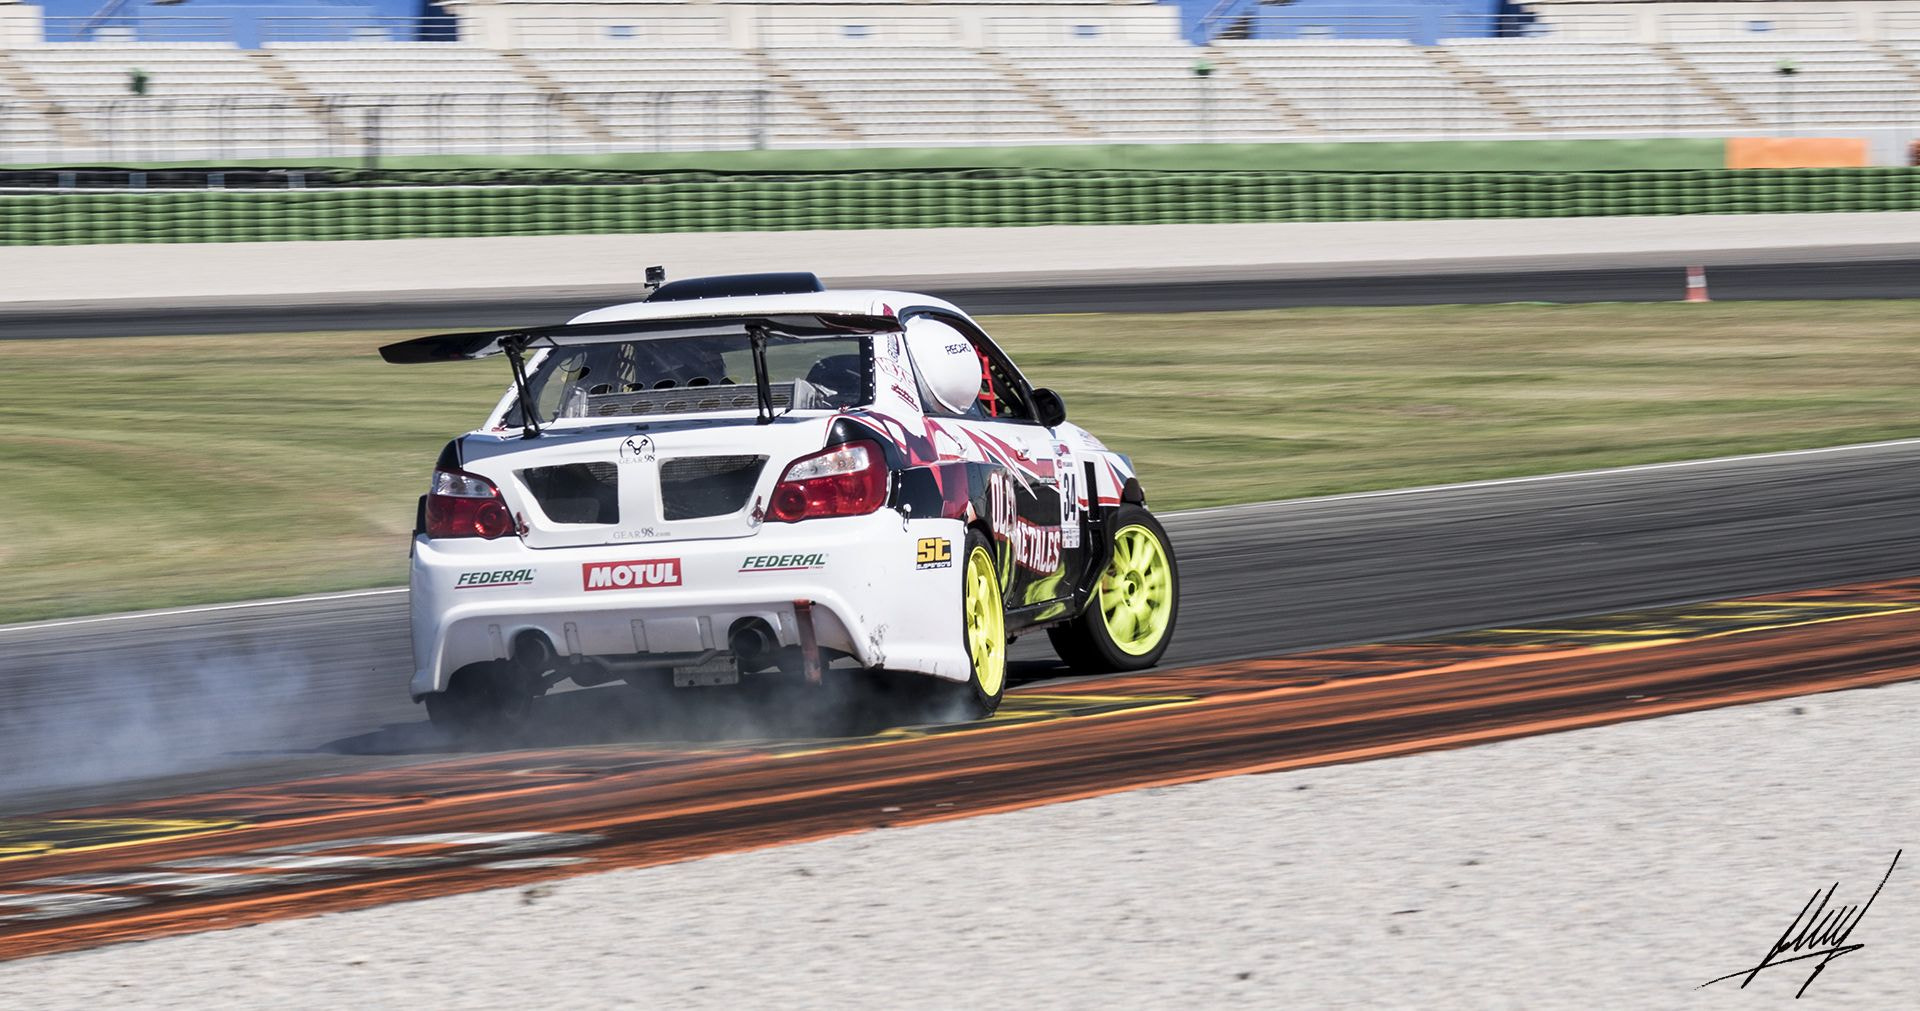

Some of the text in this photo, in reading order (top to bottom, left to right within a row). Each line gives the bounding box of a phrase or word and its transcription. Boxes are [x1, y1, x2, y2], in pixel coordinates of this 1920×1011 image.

[1063, 473, 1076, 521] 34
[742, 553, 826, 569] FEDERAL
[457, 568, 534, 585] FEDERAL
[588, 563, 678, 588] MOTUL
